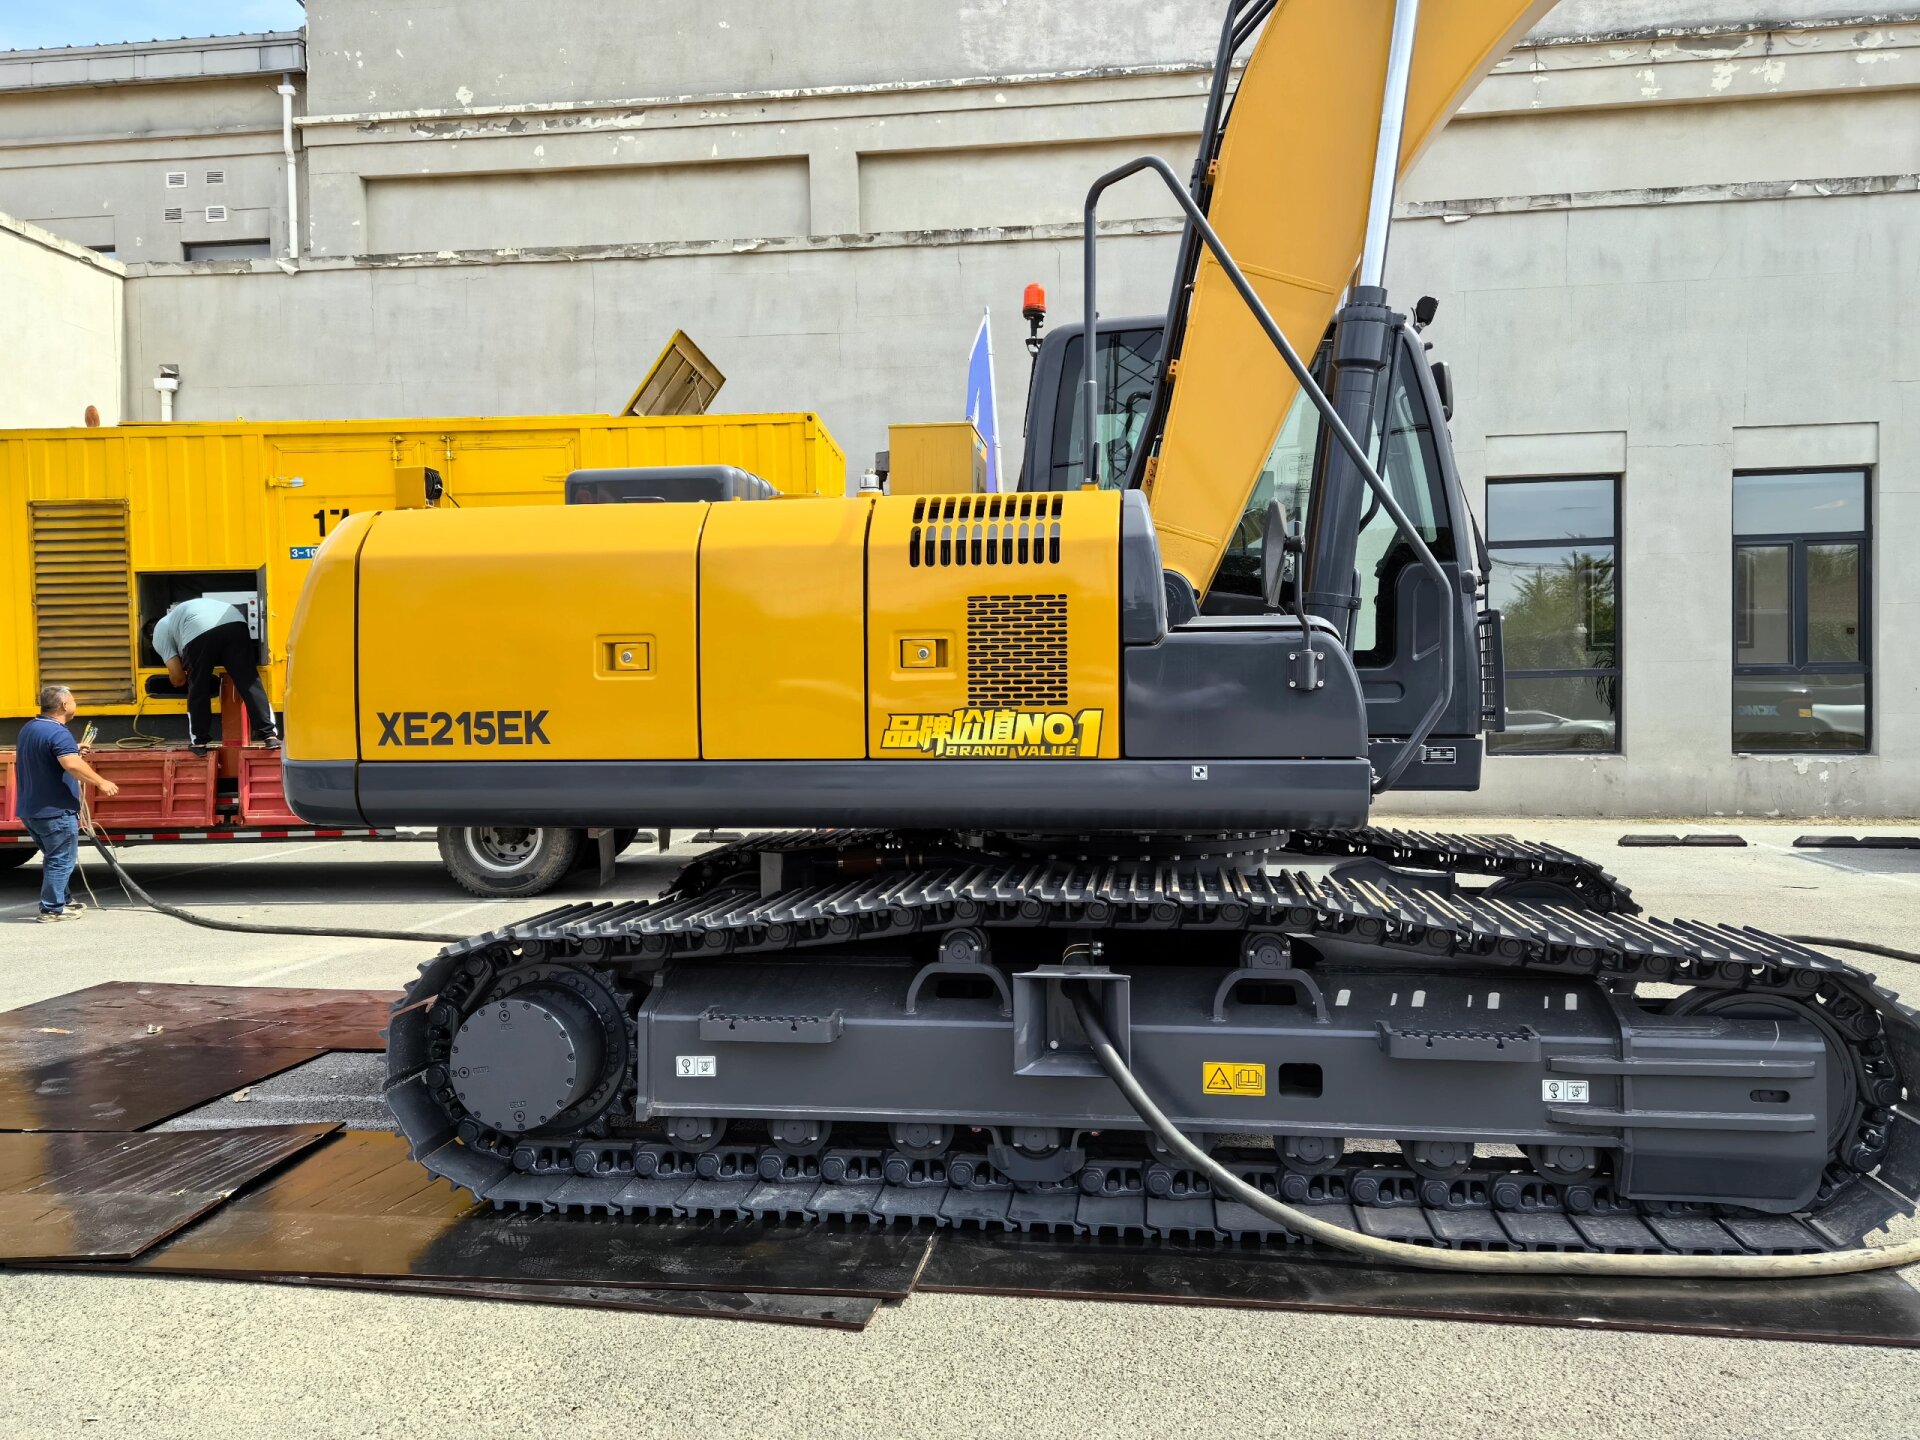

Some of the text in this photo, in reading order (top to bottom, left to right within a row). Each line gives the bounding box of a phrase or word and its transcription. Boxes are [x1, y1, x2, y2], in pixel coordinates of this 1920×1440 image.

[376, 710, 551, 746] XE215EK
[945, 745, 1077, 757] BRAND VALUE
